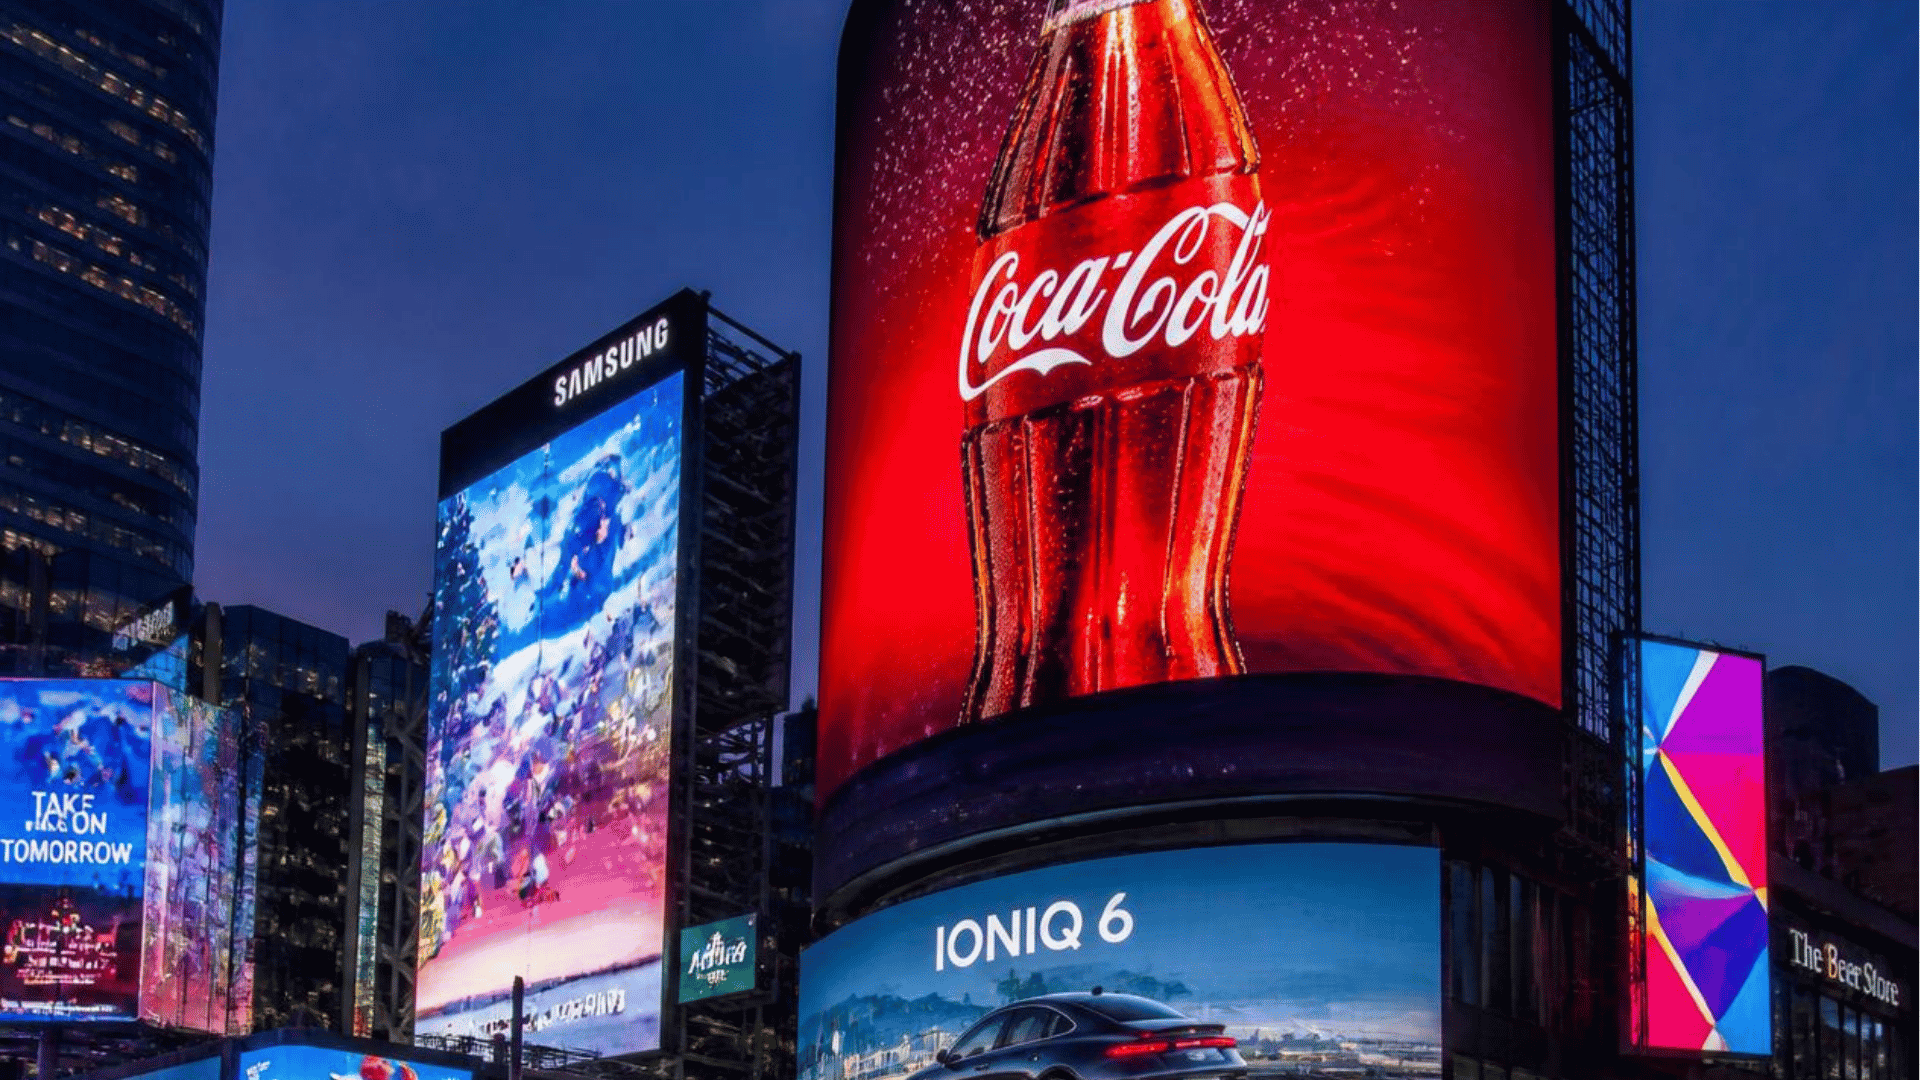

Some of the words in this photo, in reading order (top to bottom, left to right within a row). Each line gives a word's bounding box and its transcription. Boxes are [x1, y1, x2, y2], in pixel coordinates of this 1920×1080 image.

[959, 199, 1271, 401] Coca-Cola
[554, 317, 669, 407] SAMSUNG
[0, 838, 133, 864] TOMORROW
[72, 810, 107, 835] ON
[936, 900, 1083, 972] IONIQ
[1098, 892, 1134, 943] 6
[1789, 927, 1823, 973] The
[1825, 943, 1861, 990] Beer
[1863, 962, 1899, 1006] Store
